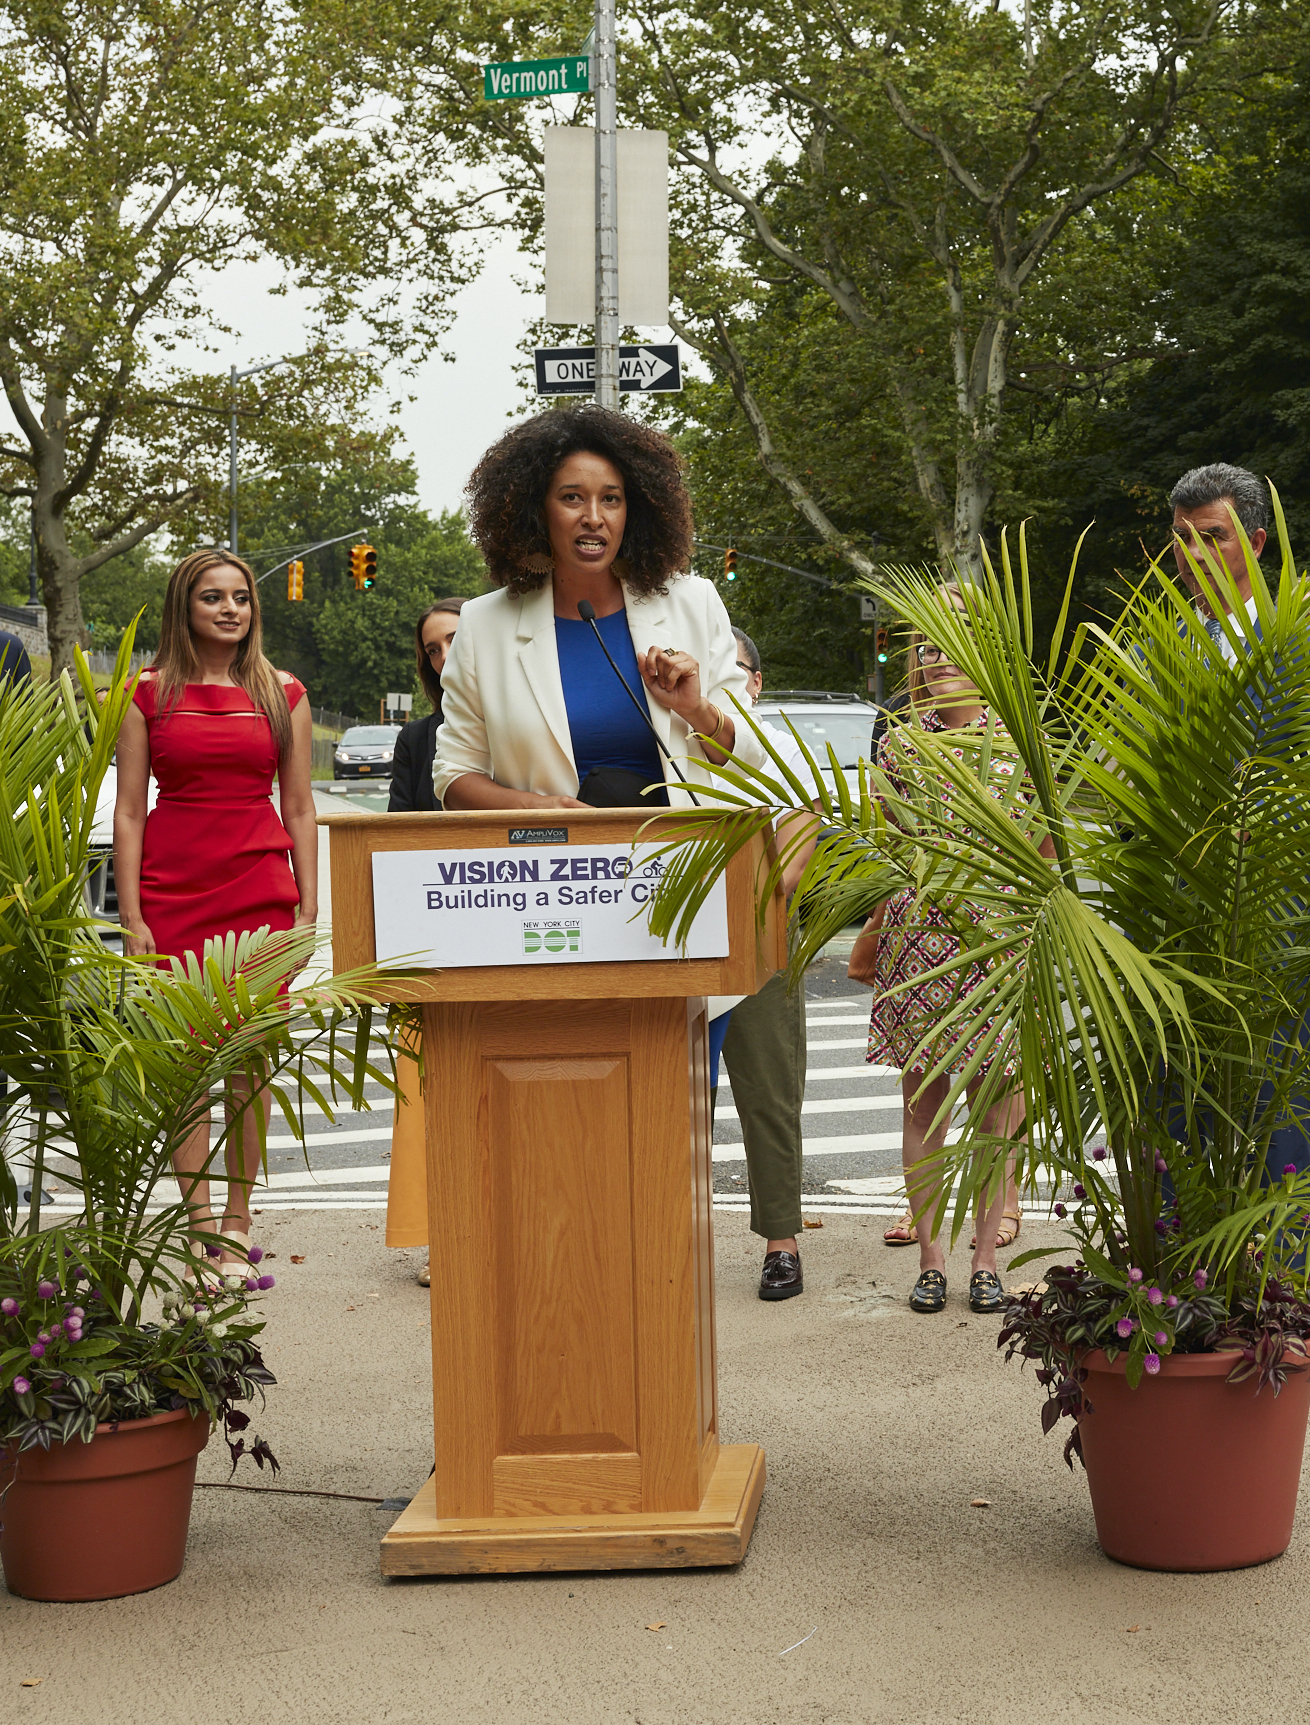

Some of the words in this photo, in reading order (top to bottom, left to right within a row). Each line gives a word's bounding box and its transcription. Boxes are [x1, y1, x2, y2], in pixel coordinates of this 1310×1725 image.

[490, 63, 568, 95] Vermont
[576, 61, 587, 78] Pl
[557, 362, 595, 380] ONE
[619, 360, 658, 378] WAY
[437, 858, 540, 885] VISION
[549, 856, 634, 882] ZERO
[426, 888, 527, 912] Building
[535, 890, 550, 907] a
[557, 884, 623, 907] Safer
[543, 920, 562, 928] YORK
[524, 929, 580, 953] DOT
